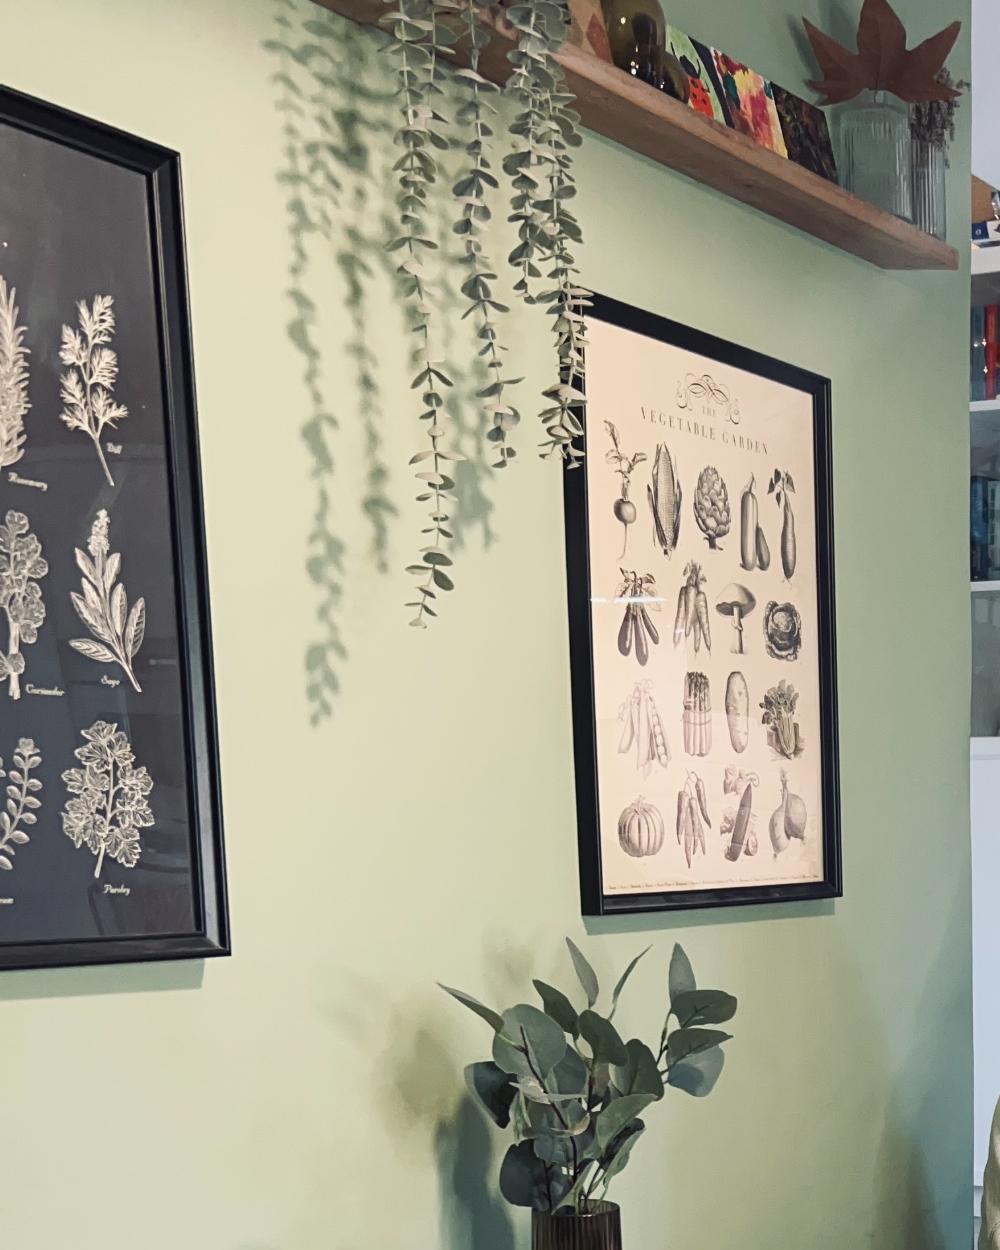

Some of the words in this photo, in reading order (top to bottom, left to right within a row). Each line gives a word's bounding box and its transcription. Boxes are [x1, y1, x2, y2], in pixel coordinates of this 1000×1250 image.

[702, 405, 716, 417] THE
[641, 406, 716, 441] VEGETABLE
[722, 431, 769, 455] GARDEN
